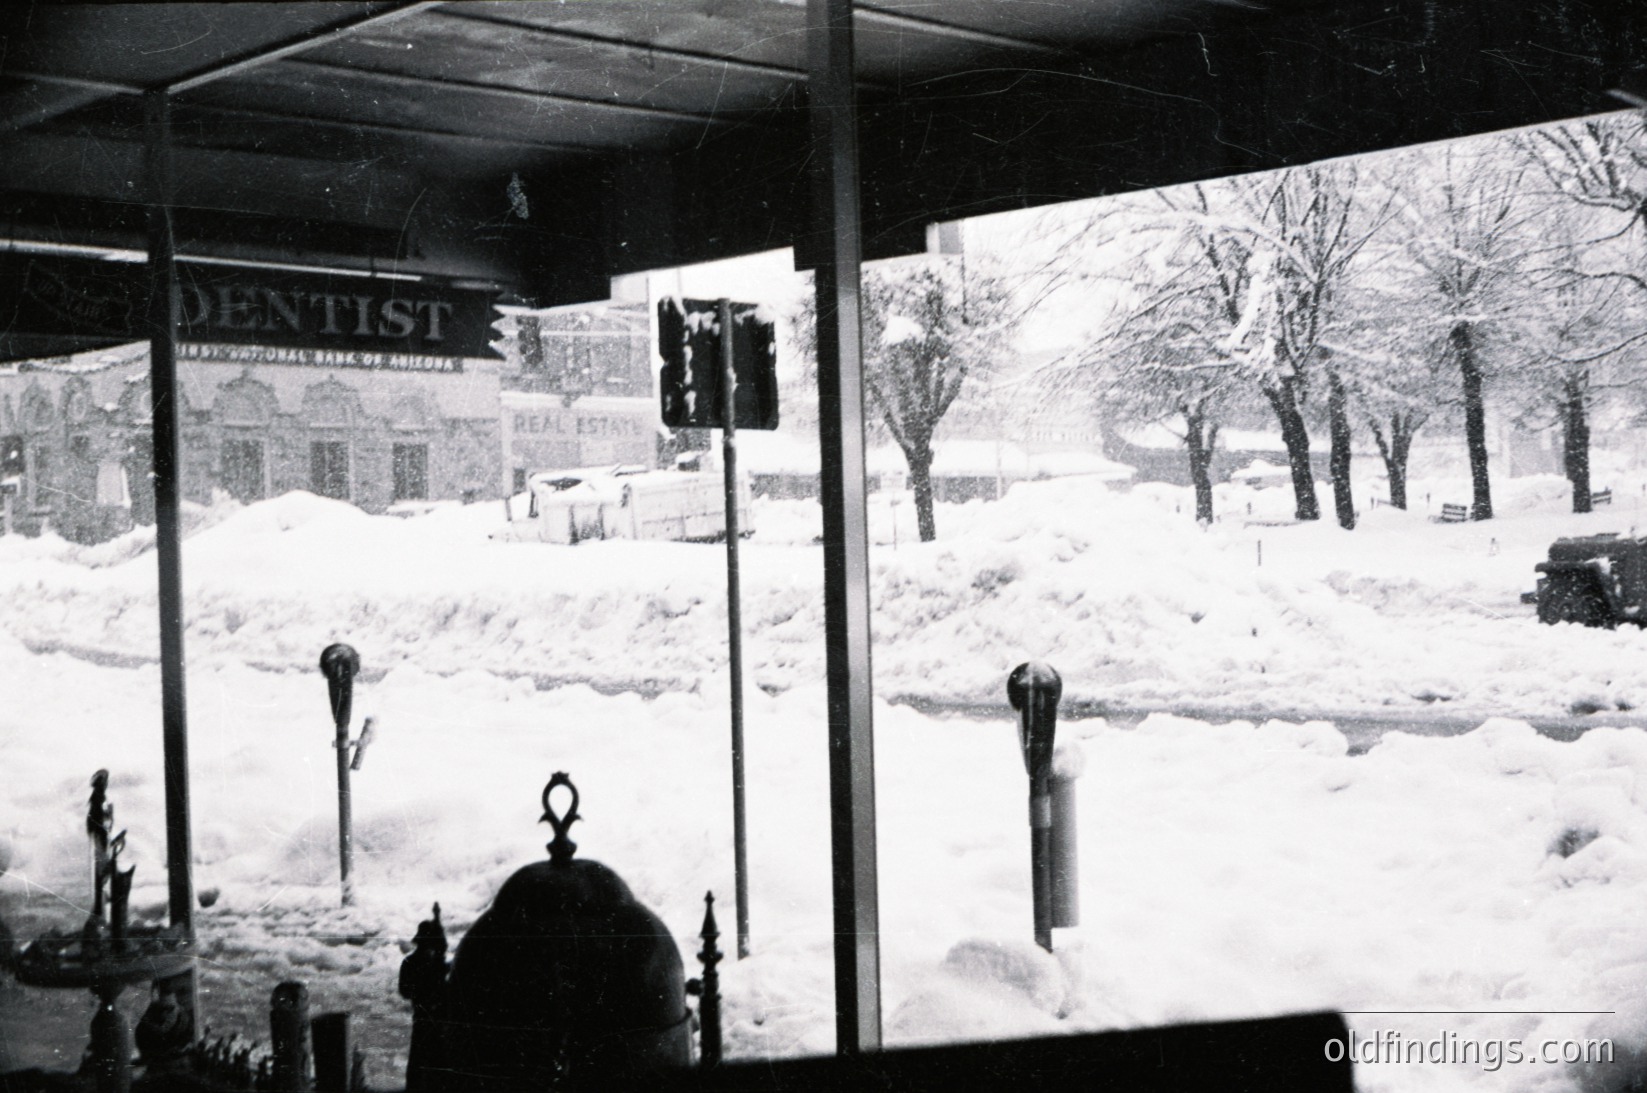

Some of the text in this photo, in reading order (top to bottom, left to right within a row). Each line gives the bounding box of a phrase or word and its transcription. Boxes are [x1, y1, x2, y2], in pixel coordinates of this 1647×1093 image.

[177, 283, 452, 341] DENTIST
[228, 345, 307, 364] NATIONAL
[314, 349, 357, 366] BANK
[362, 352, 382, 367] OF
[390, 354, 454, 371] ARIZONA
[512, 413, 643, 436] REAL ESTATE
